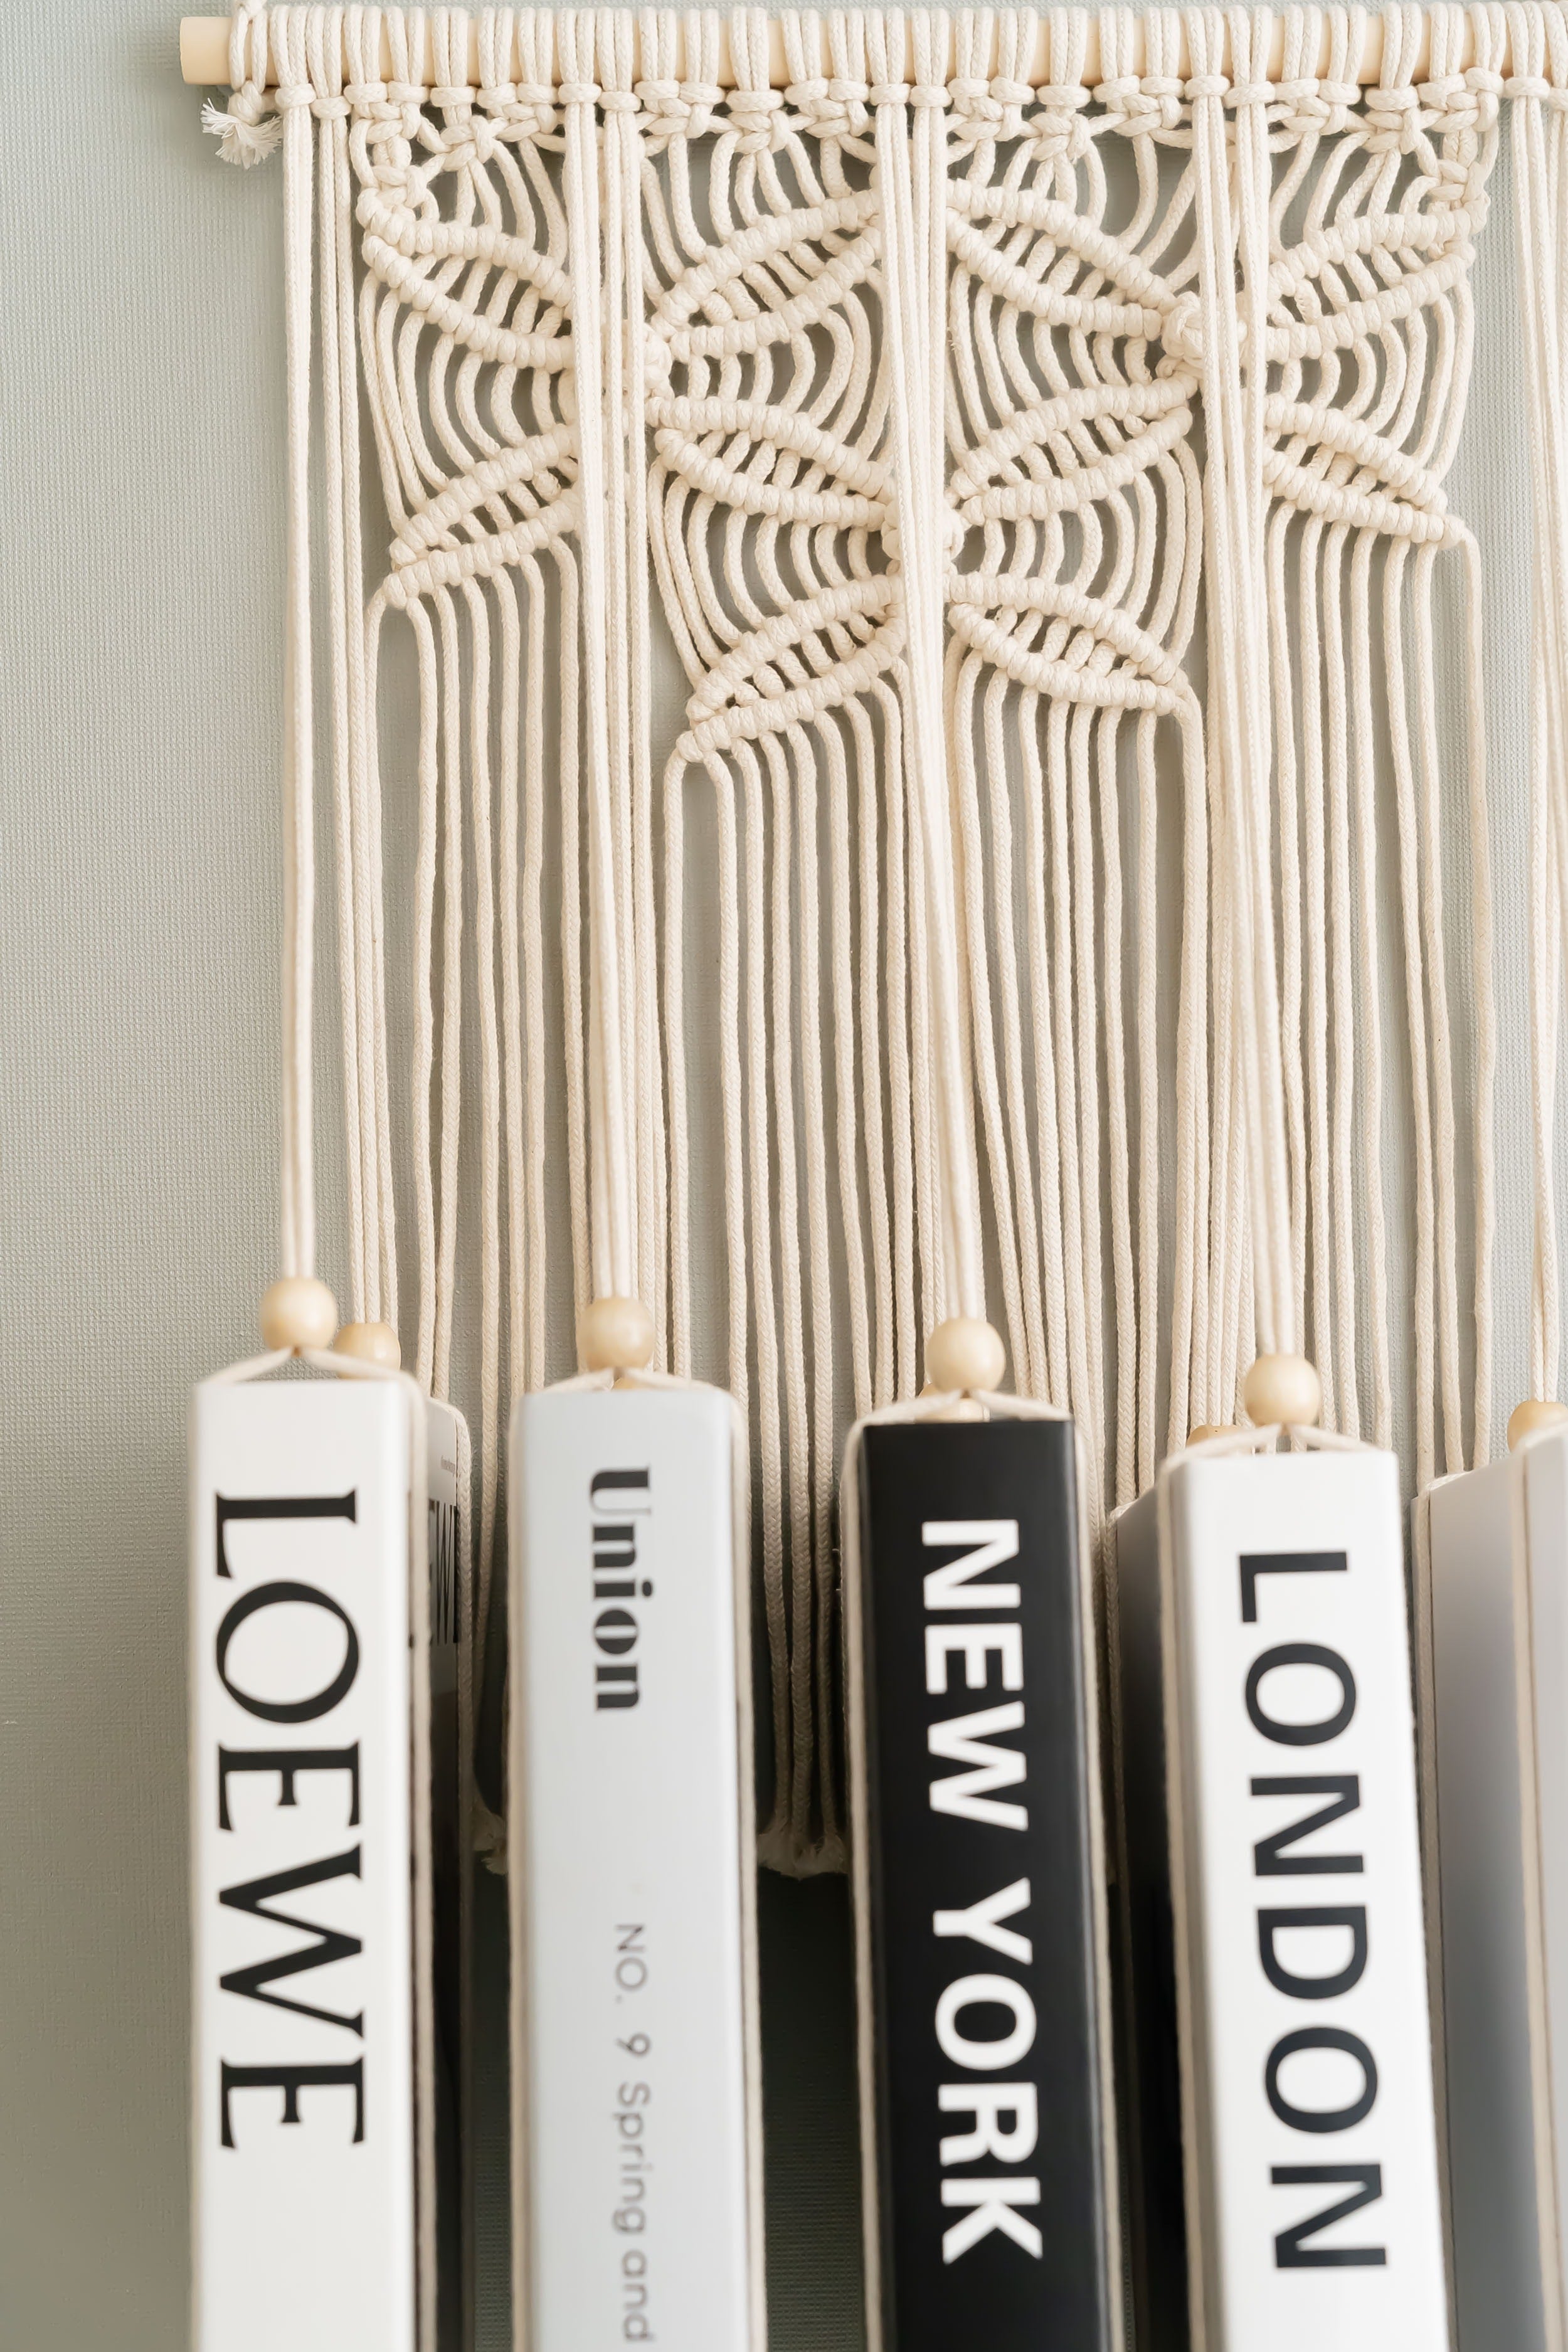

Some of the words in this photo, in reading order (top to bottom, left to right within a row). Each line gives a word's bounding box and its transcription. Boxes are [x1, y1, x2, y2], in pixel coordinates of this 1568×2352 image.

[590, 1466, 654, 1711] Union
[921, 1518, 1029, 1831] NEW
[215, 1488, 365, 2150] LOEWE
[1238, 1550, 1387, 2269] LONDON
[614, 1923, 649, 2004] NO.
[614, 2032, 652, 2059] 9
[933, 1877, 1043, 2264] YORK
[611, 2080, 654, 2236] Spring
[620, 2248, 657, 2344] and
